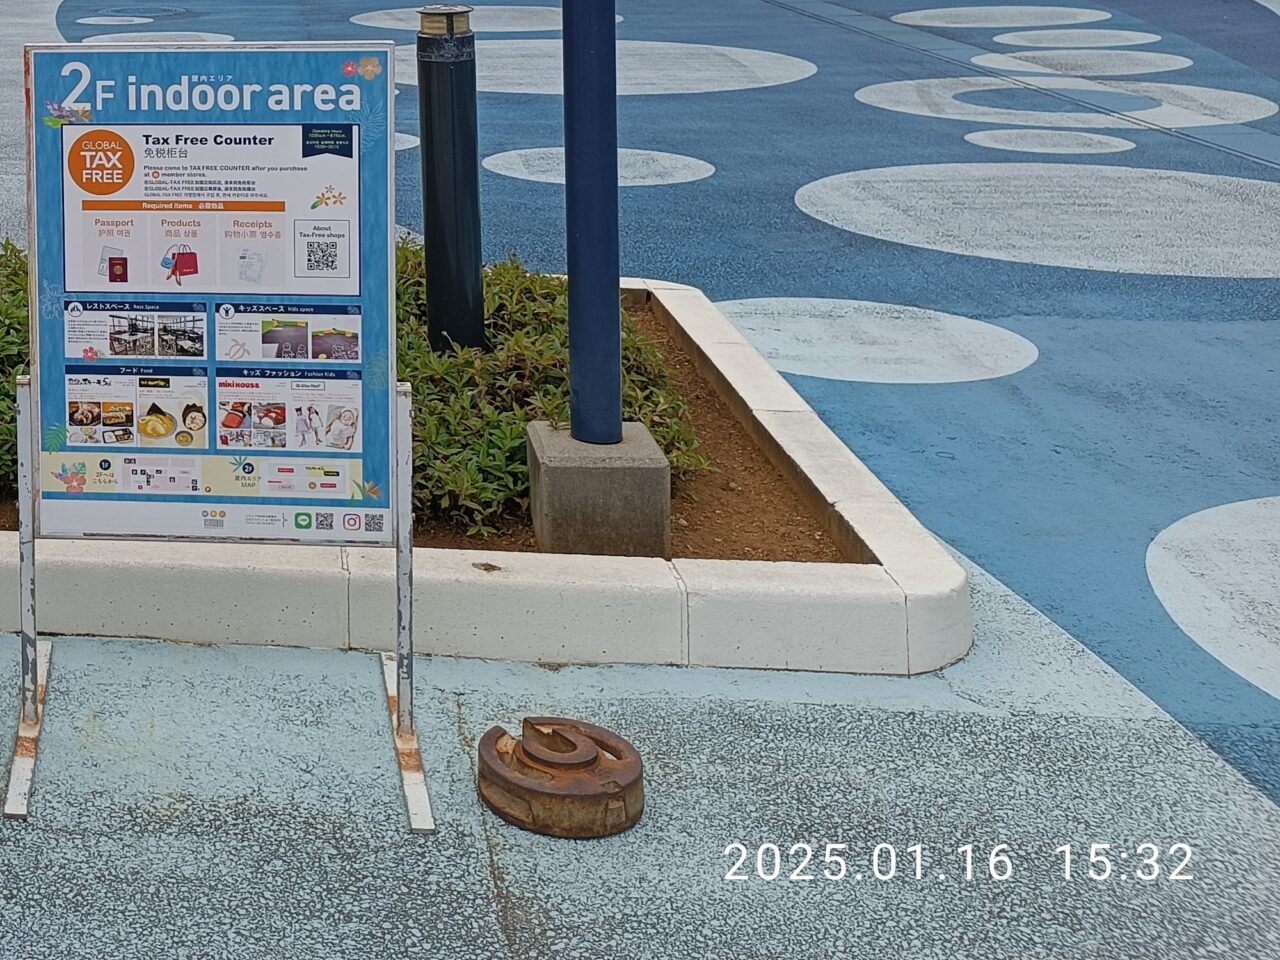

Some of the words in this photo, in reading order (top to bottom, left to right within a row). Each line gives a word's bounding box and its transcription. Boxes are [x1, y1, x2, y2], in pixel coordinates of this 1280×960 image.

[60, 61, 116, 111] 2F
[127, 75, 263, 111] indoor
[268, 83, 362, 111] area
[81, 140, 123, 150] GLOBAL
[142, 134, 170, 146] Tax
[175, 134, 208, 146] Free
[213, 134, 275, 146] Counter
[143, 147, 189, 159] 免税柜台
[80, 151, 123, 169] TAX
[82, 169, 123, 183] FREE
[142, 202, 173, 210] Required
[94, 218, 135, 228] Passport
[160, 219, 202, 228] Products
[233, 220, 273, 230] Receipts
